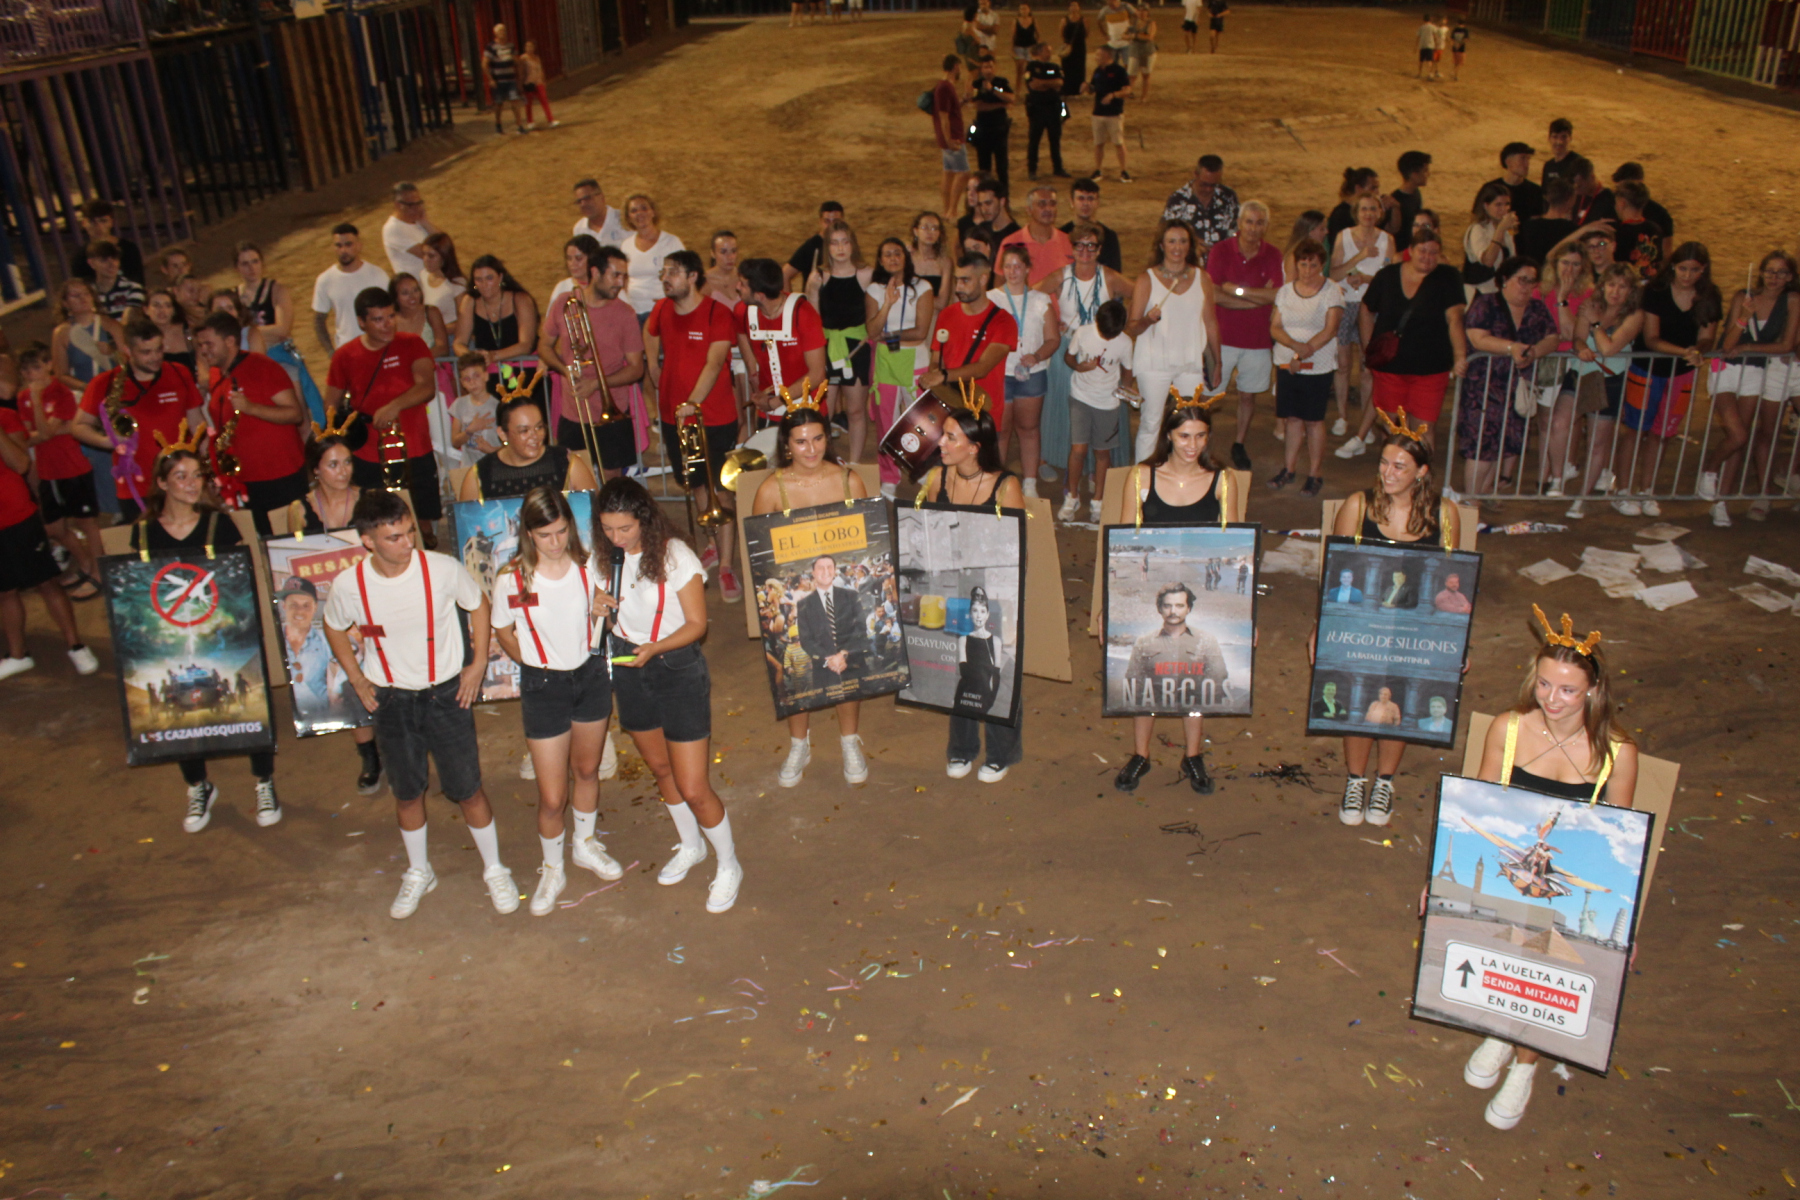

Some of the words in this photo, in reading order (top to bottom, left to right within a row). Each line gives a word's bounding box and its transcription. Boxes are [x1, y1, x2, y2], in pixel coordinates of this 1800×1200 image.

[779, 536, 800, 551] EL
[813, 525, 860, 544] LOBO
[907, 636, 957, 651] DESAYUNO
[1376, 635, 1394, 649] DE
[1395, 636, 1458, 654] SILLONES
[940, 654, 956, 663] CON
[1154, 662, 1205, 676] NETFLIX
[1122, 677, 1235, 708] NARCOS
[164, 722, 263, 740] CAZAMOSQUITOS
[1480, 956, 1497, 969] LA
[1503, 962, 1551, 983] VUELTA
[1556, 977, 1565, 987] A
[1570, 980, 1588, 993] LA
[1483, 975, 1522, 994] SENDA
[1525, 986, 1577, 1010] MITJANA
[1488, 995, 1506, 1008] EN
[1510, 1001, 1528, 1014] 80
[1532, 1008, 1566, 1026] DÍAS
